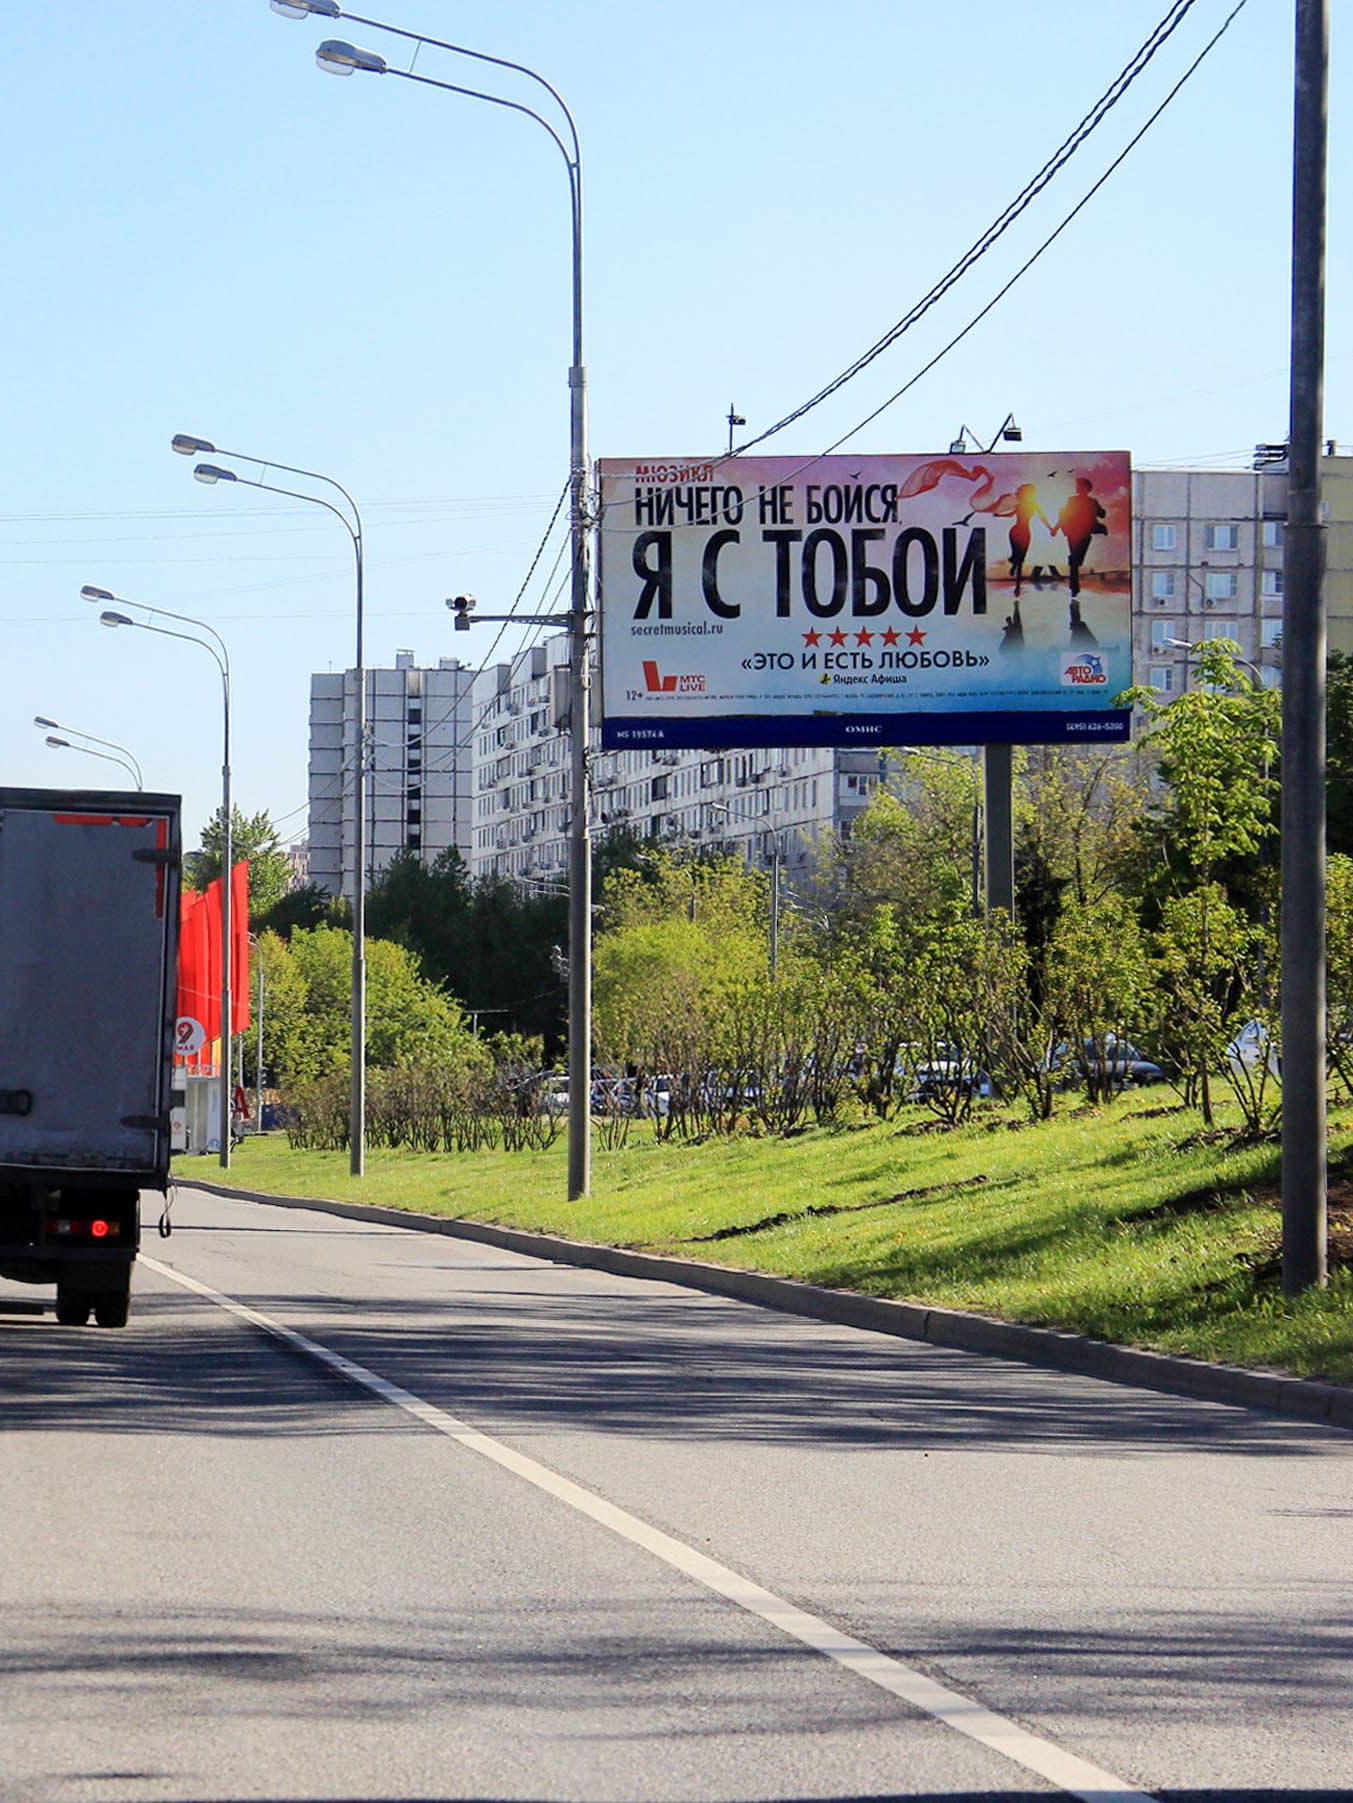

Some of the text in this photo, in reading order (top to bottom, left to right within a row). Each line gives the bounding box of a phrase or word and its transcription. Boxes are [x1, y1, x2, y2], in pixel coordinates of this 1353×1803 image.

[635, 464, 714, 483] МЮЗИКЛ
[635, 485, 744, 526] НИЧЕГО
[759, 485, 794, 525] НЕ
[632, 526, 988, 619] Я С ТОБОЙ
[631, 620, 724, 636] secretmusical.ru
[741, 650, 990, 671] «ЭТО И ЕСТЬ ЛЮБОВЬ»
[679, 683, 706, 692] LIVE
[833, 673, 908, 685] Яндекс Афиша
[626, 690, 644, 701] 12+
